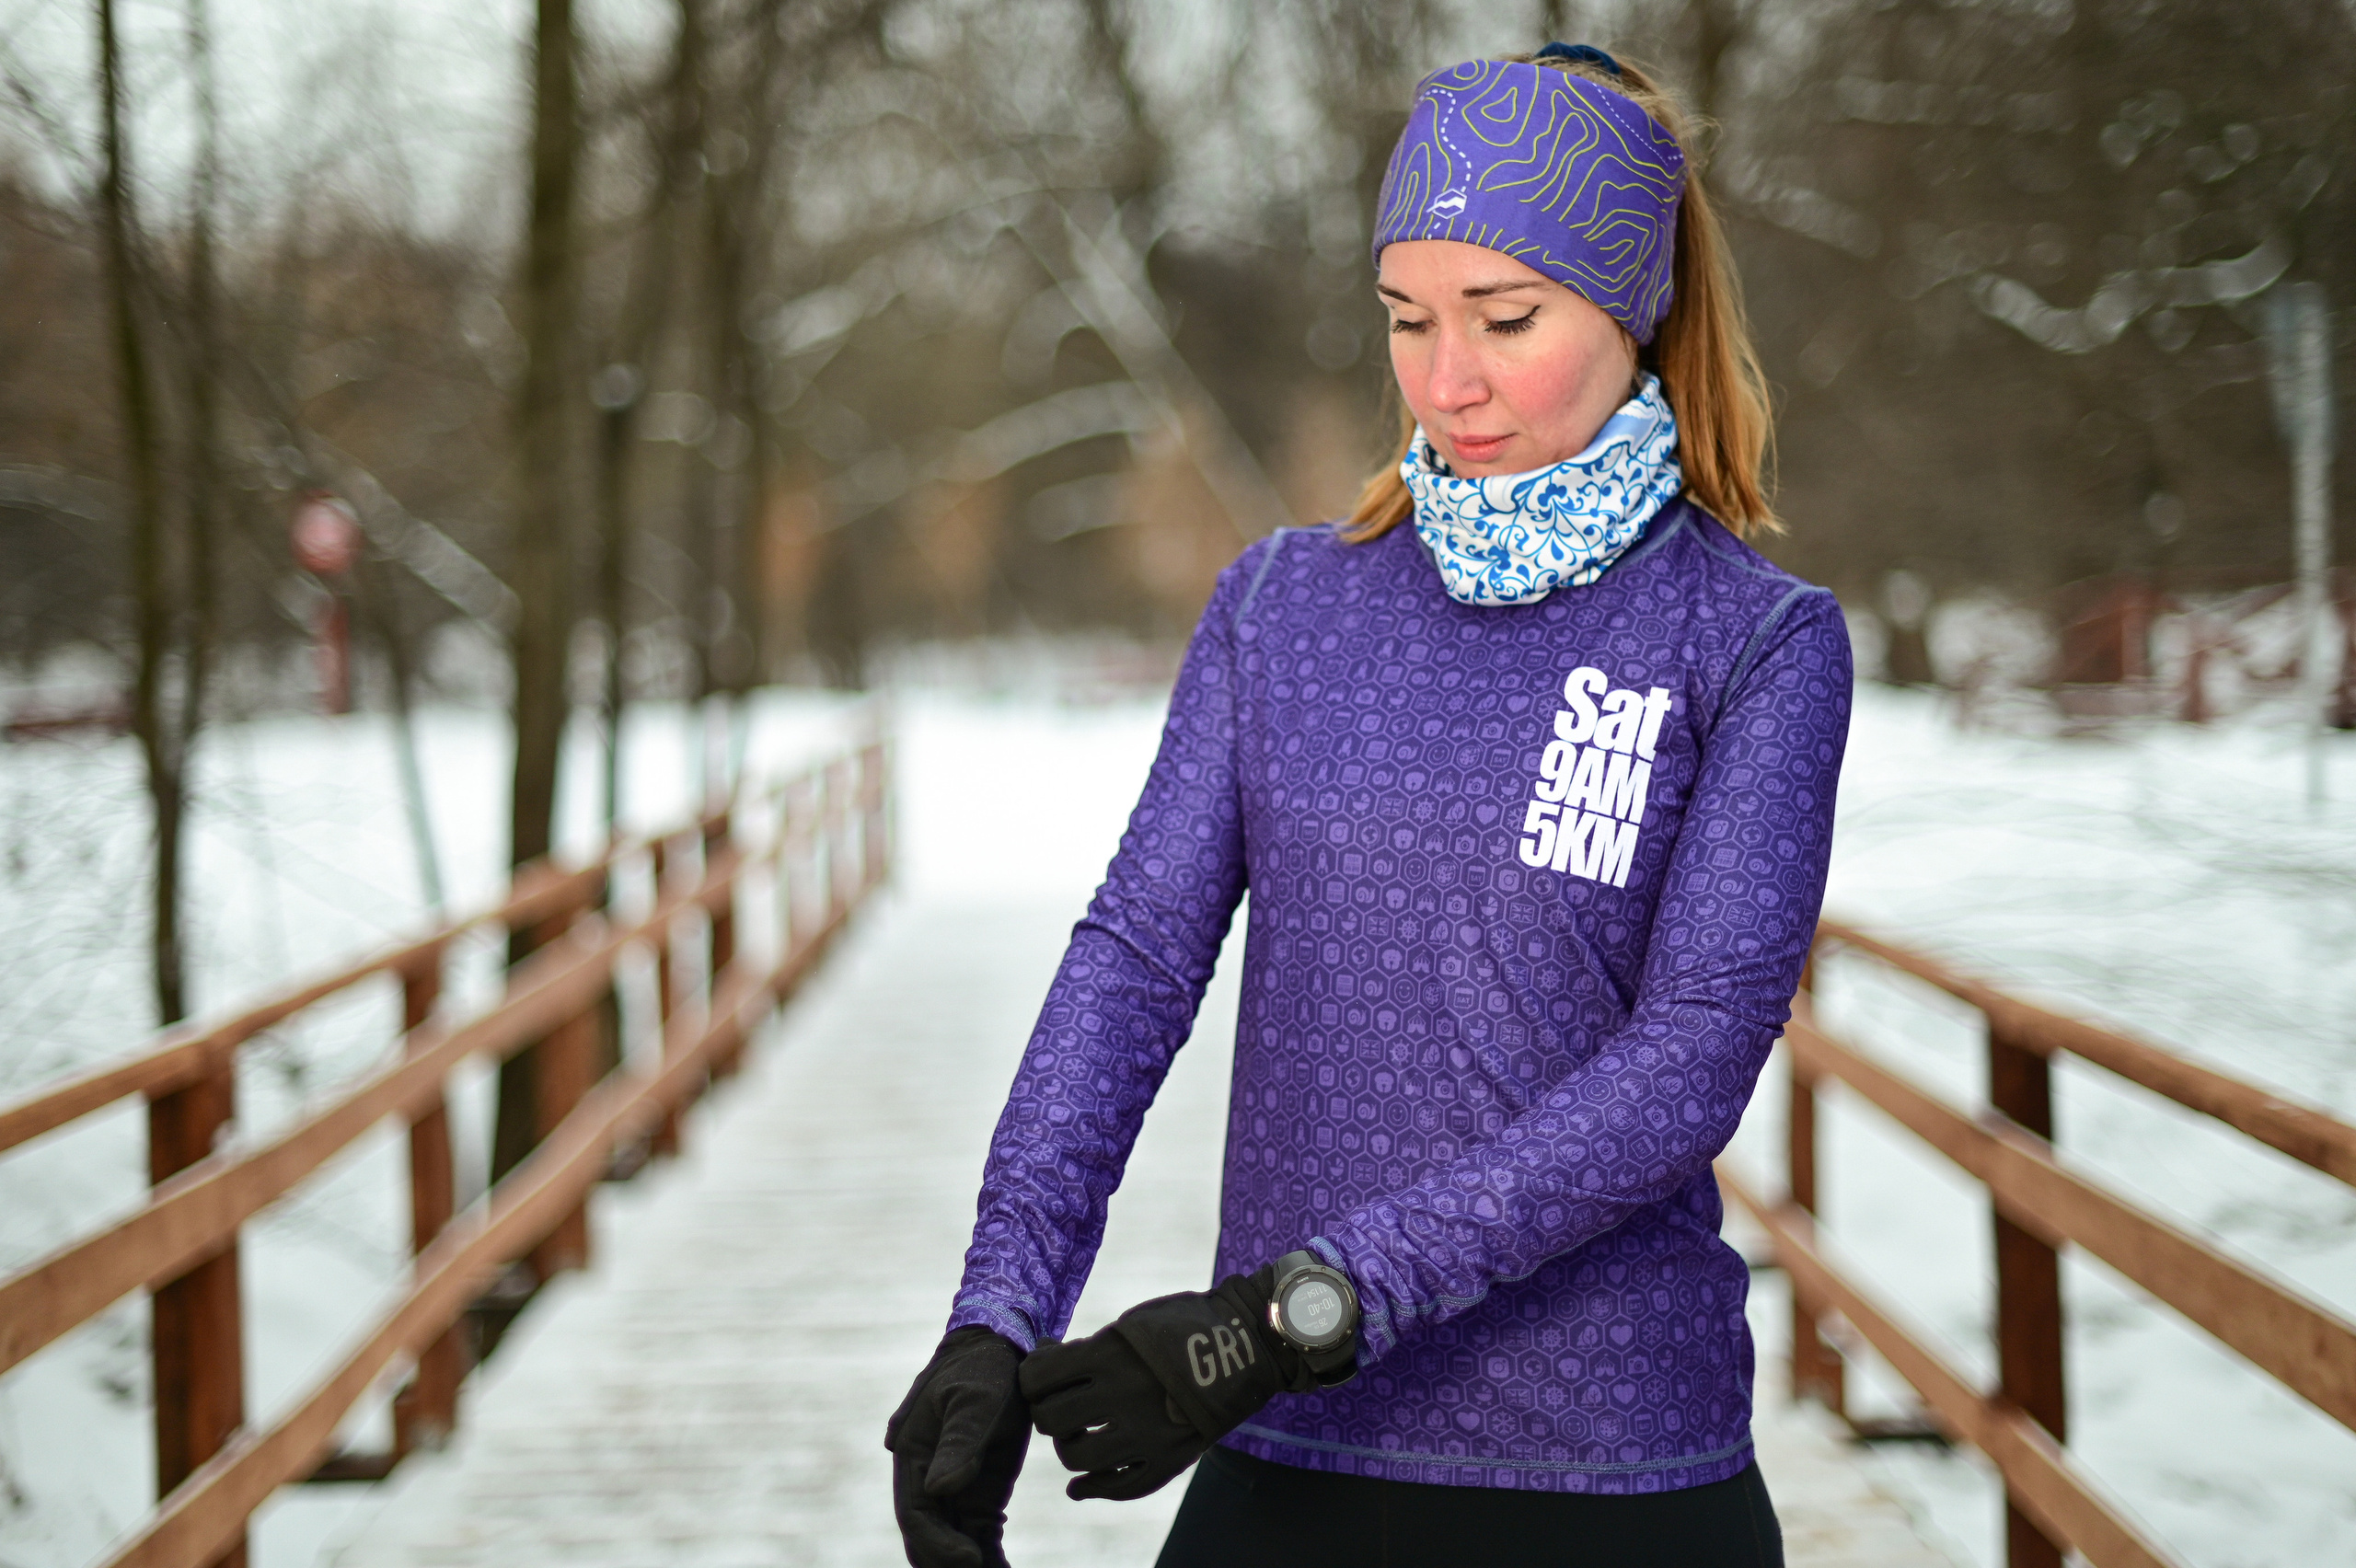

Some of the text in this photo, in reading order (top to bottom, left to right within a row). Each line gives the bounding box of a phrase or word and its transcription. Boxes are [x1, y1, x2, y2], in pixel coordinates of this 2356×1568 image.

[1553, 666, 1672, 762] Sat
[1535, 740, 1653, 824] 9AM
[1519, 800, 1640, 889] 5KM
[1307, 1297, 1335, 1316] 10:40
[1318, 1317, 1328, 1327] 26
